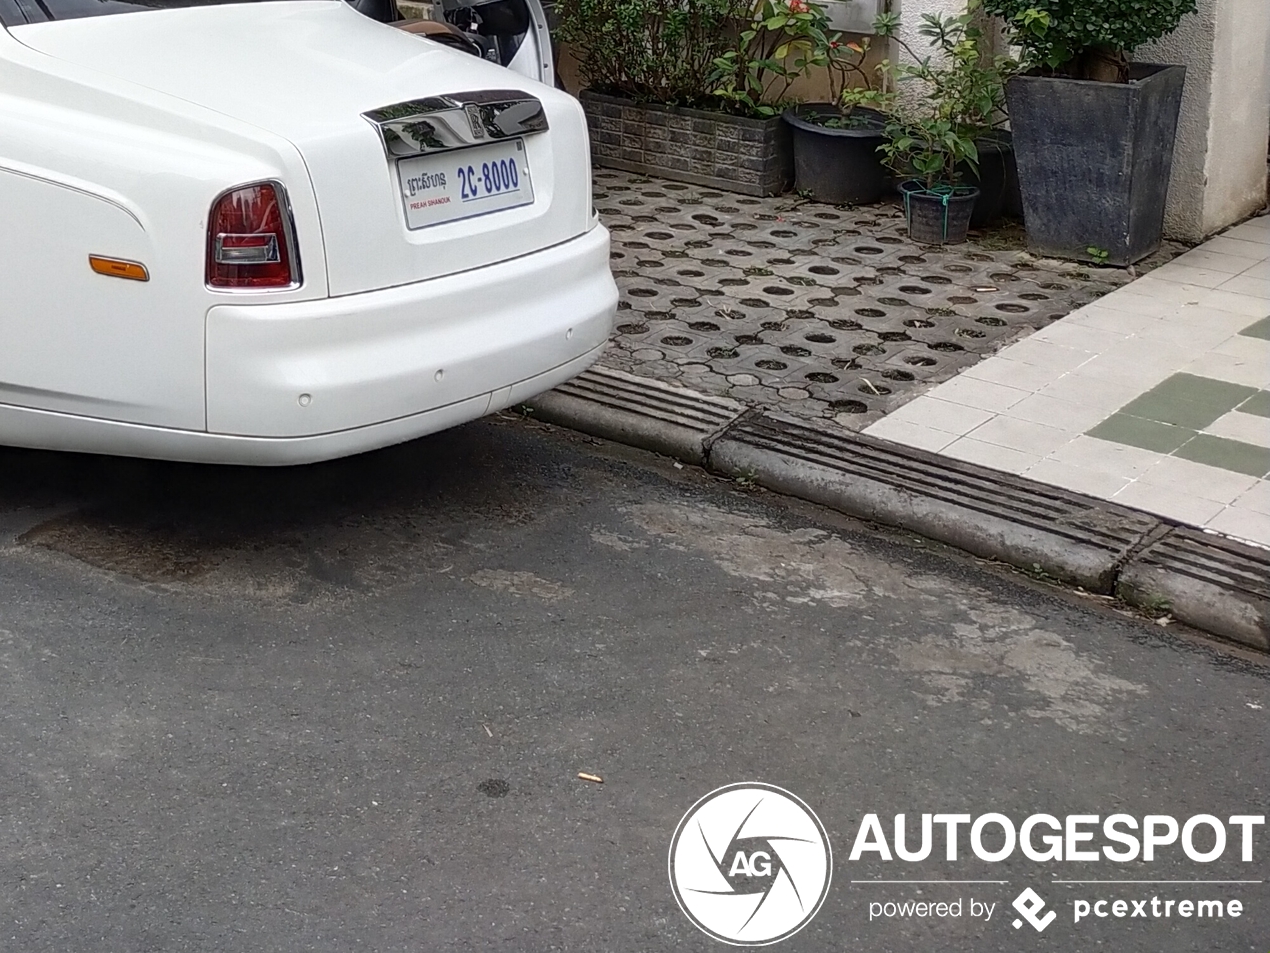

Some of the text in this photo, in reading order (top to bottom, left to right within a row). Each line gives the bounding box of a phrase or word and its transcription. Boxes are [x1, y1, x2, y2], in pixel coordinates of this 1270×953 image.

[457, 157, 519, 200] 2C-8000
[410, 196, 451, 211] PREAH SIHANOUK
